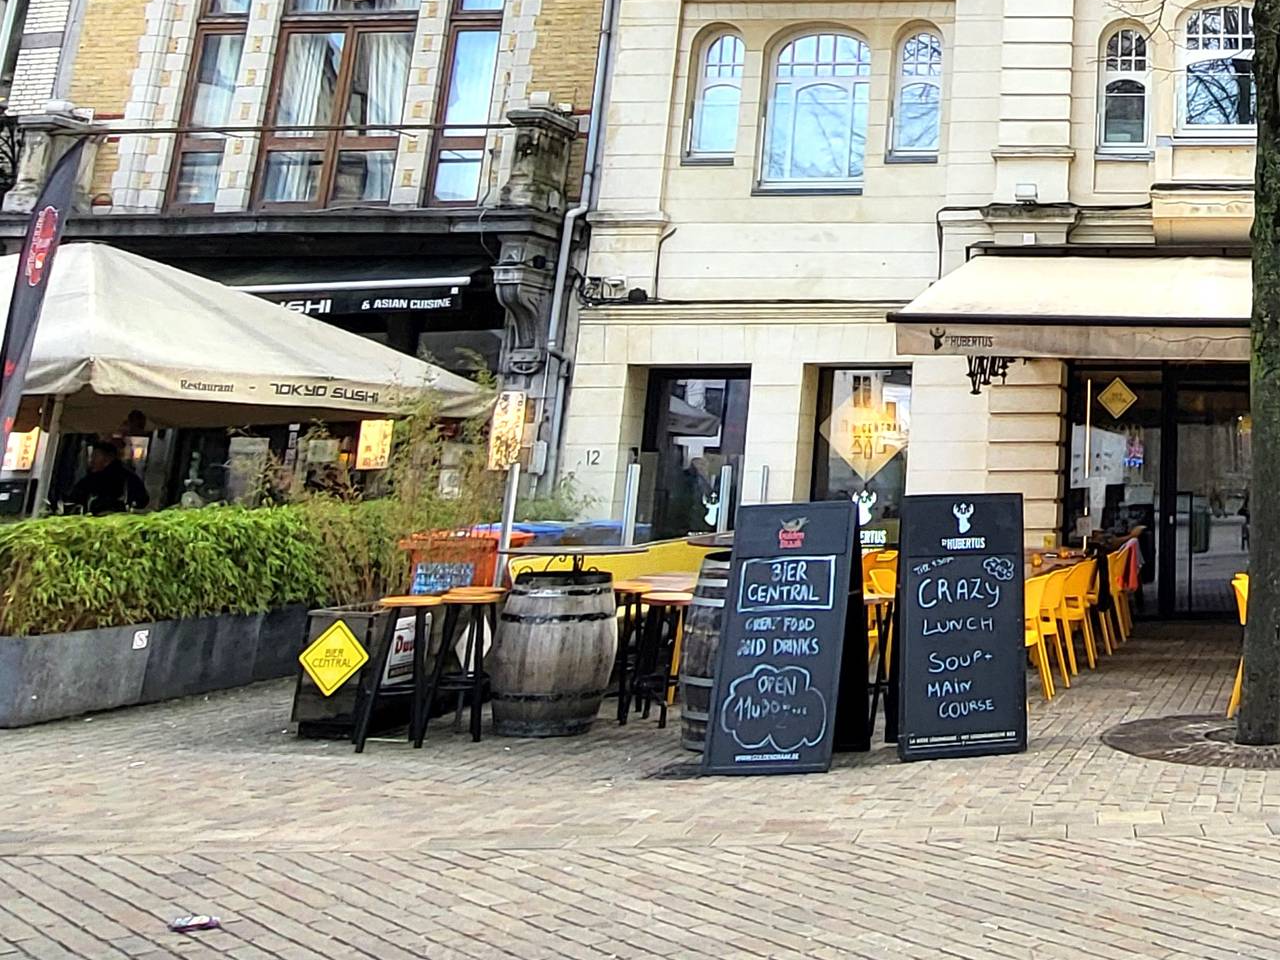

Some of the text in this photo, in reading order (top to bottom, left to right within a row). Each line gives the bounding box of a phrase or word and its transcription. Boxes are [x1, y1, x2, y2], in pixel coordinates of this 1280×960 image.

[361, 296, 452, 311] & ASIAN CUISINE
[950, 335, 993, 348] HUBERTUS
[180, 379, 234, 393] Restaurant
[269, 383, 327, 396] TOKYO
[585, 450, 600, 466] 12
[947, 537, 986, 550] HUBERTUS
[748, 583, 820, 604] CENTRAL
[917, 577, 1000, 609] CRAZY
[783, 616, 815, 632] FOOD
[922, 616, 994, 636] LUNCH
[324, 648, 345, 658] BIER
[773, 638, 819, 656] DRINKS
[312, 657, 352, 668] CENTRAL
[758, 675, 797, 696] OPEN
[927, 678, 972, 697] MAIN
[938, 699, 995, 718] COURSE
